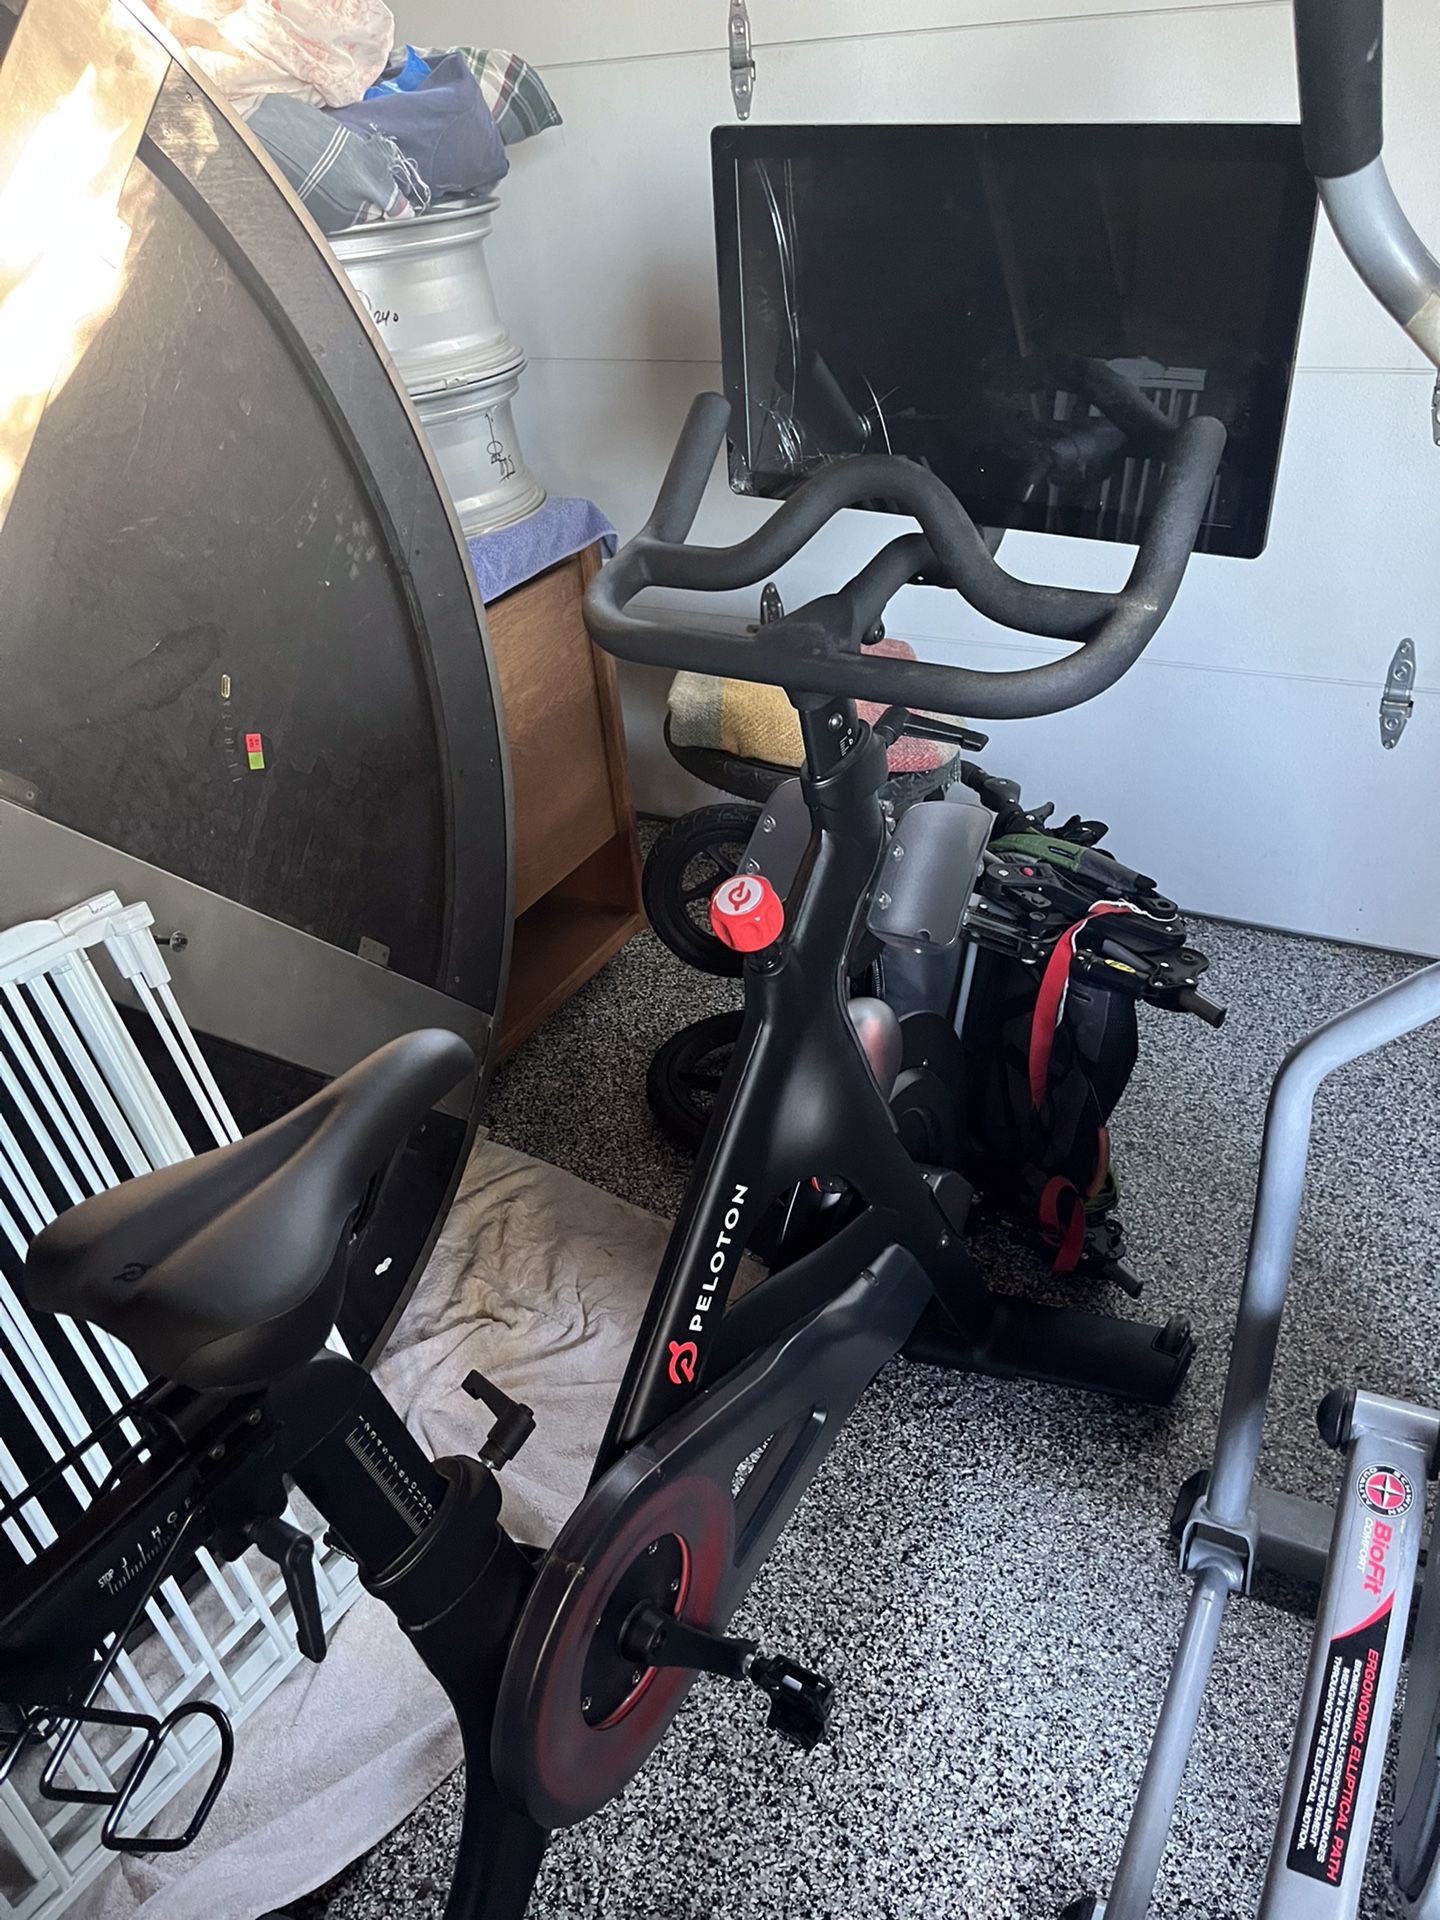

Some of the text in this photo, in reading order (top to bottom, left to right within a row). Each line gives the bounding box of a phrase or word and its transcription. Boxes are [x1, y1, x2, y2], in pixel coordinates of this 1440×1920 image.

[688, 1183, 749, 1332] PELOTON
[370, 1430, 376, 1439] 3
[382, 1446, 388, 1454] 5
[393, 1461, 398, 1470] 7
[398, 1469, 405, 1478] 8
[408, 1482, 417, 1493] 10
[1358, 1466, 1378, 1508] QUALITY
[413, 1489, 422, 1501] 11
[418, 1495, 427, 1508] 12
[1388, 1470, 1414, 1516] SCHWINN
[98, 1568, 114, 1588] STOP
[122, 1557, 128, 1568] J
[151, 1526, 161, 1539] H
[167, 1511, 178, 1524] G
[1356, 1517, 1374, 1574] COMFORT
[1363, 1520, 1393, 1595] BioFit
[1296, 1656, 1342, 1850] THROUGHOUT THE ELLIPTICAL MOTION.
[1308, 1666, 1350, 1847] MEAN A COMFORTABLE MOVEMENT
[1315, 1658, 1362, 1863] BIOMECHANICALLY-DESIGNED LINKAGES
[1325, 1647, 1379, 1882] ERGONOMIC ELLIPTICAL PATH
